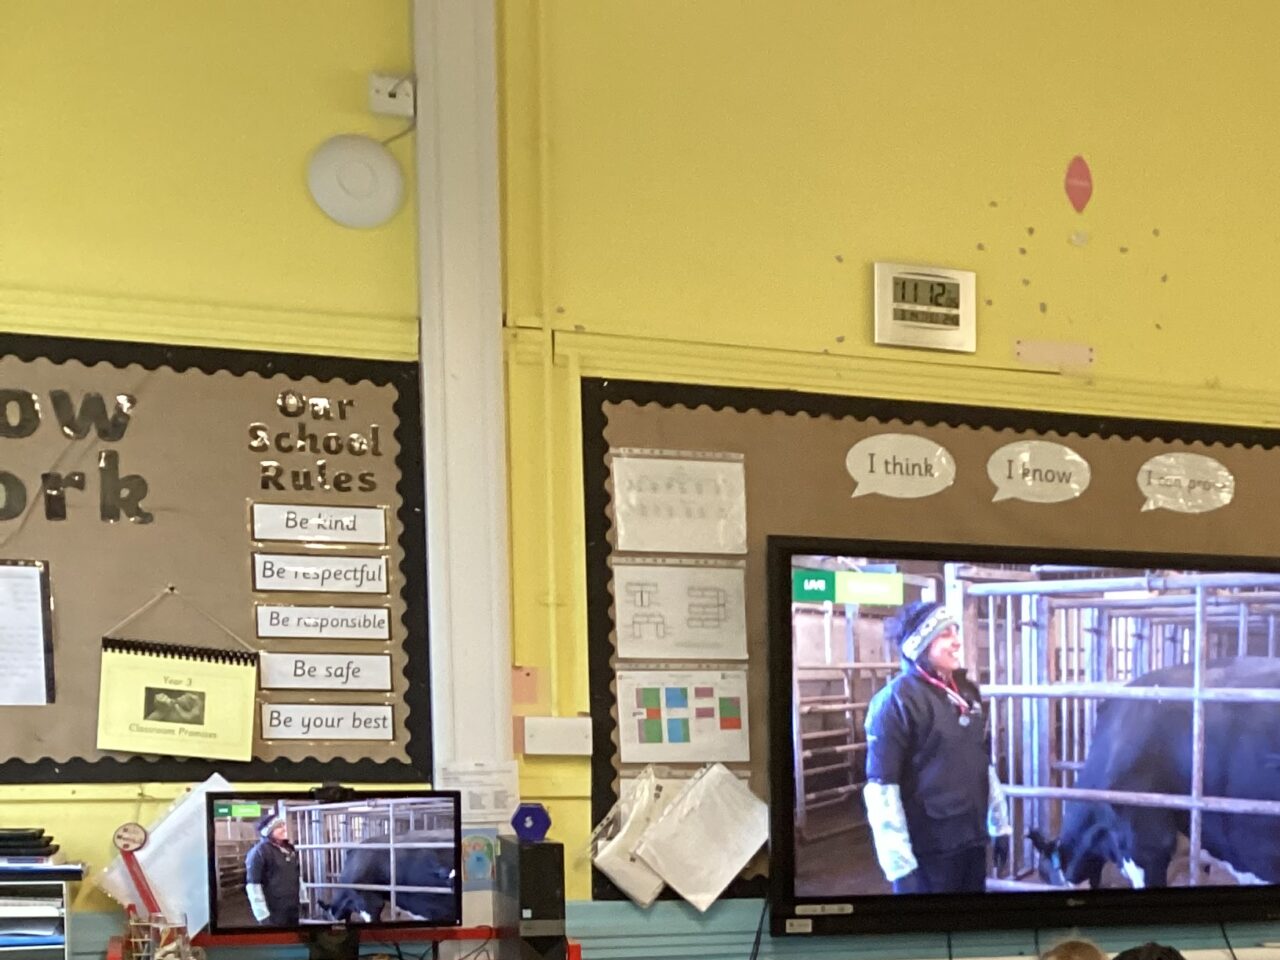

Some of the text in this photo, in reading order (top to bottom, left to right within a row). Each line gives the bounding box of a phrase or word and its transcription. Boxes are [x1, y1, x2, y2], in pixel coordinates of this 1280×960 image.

[276, 389, 354, 420] Our
[248, 422, 383, 456] School
[260, 460, 377, 492] Rules
[868, 452, 934, 478] I think
[1006, 459, 1073, 484] I know
[285, 511, 357, 532] Be kind
[262, 560, 382, 588] Be respectful
[269, 611, 385, 633] Be responsible
[163, 676, 184, 686] Year
[294, 660, 361, 684] Be safe
[269, 710, 388, 735] Be your best
